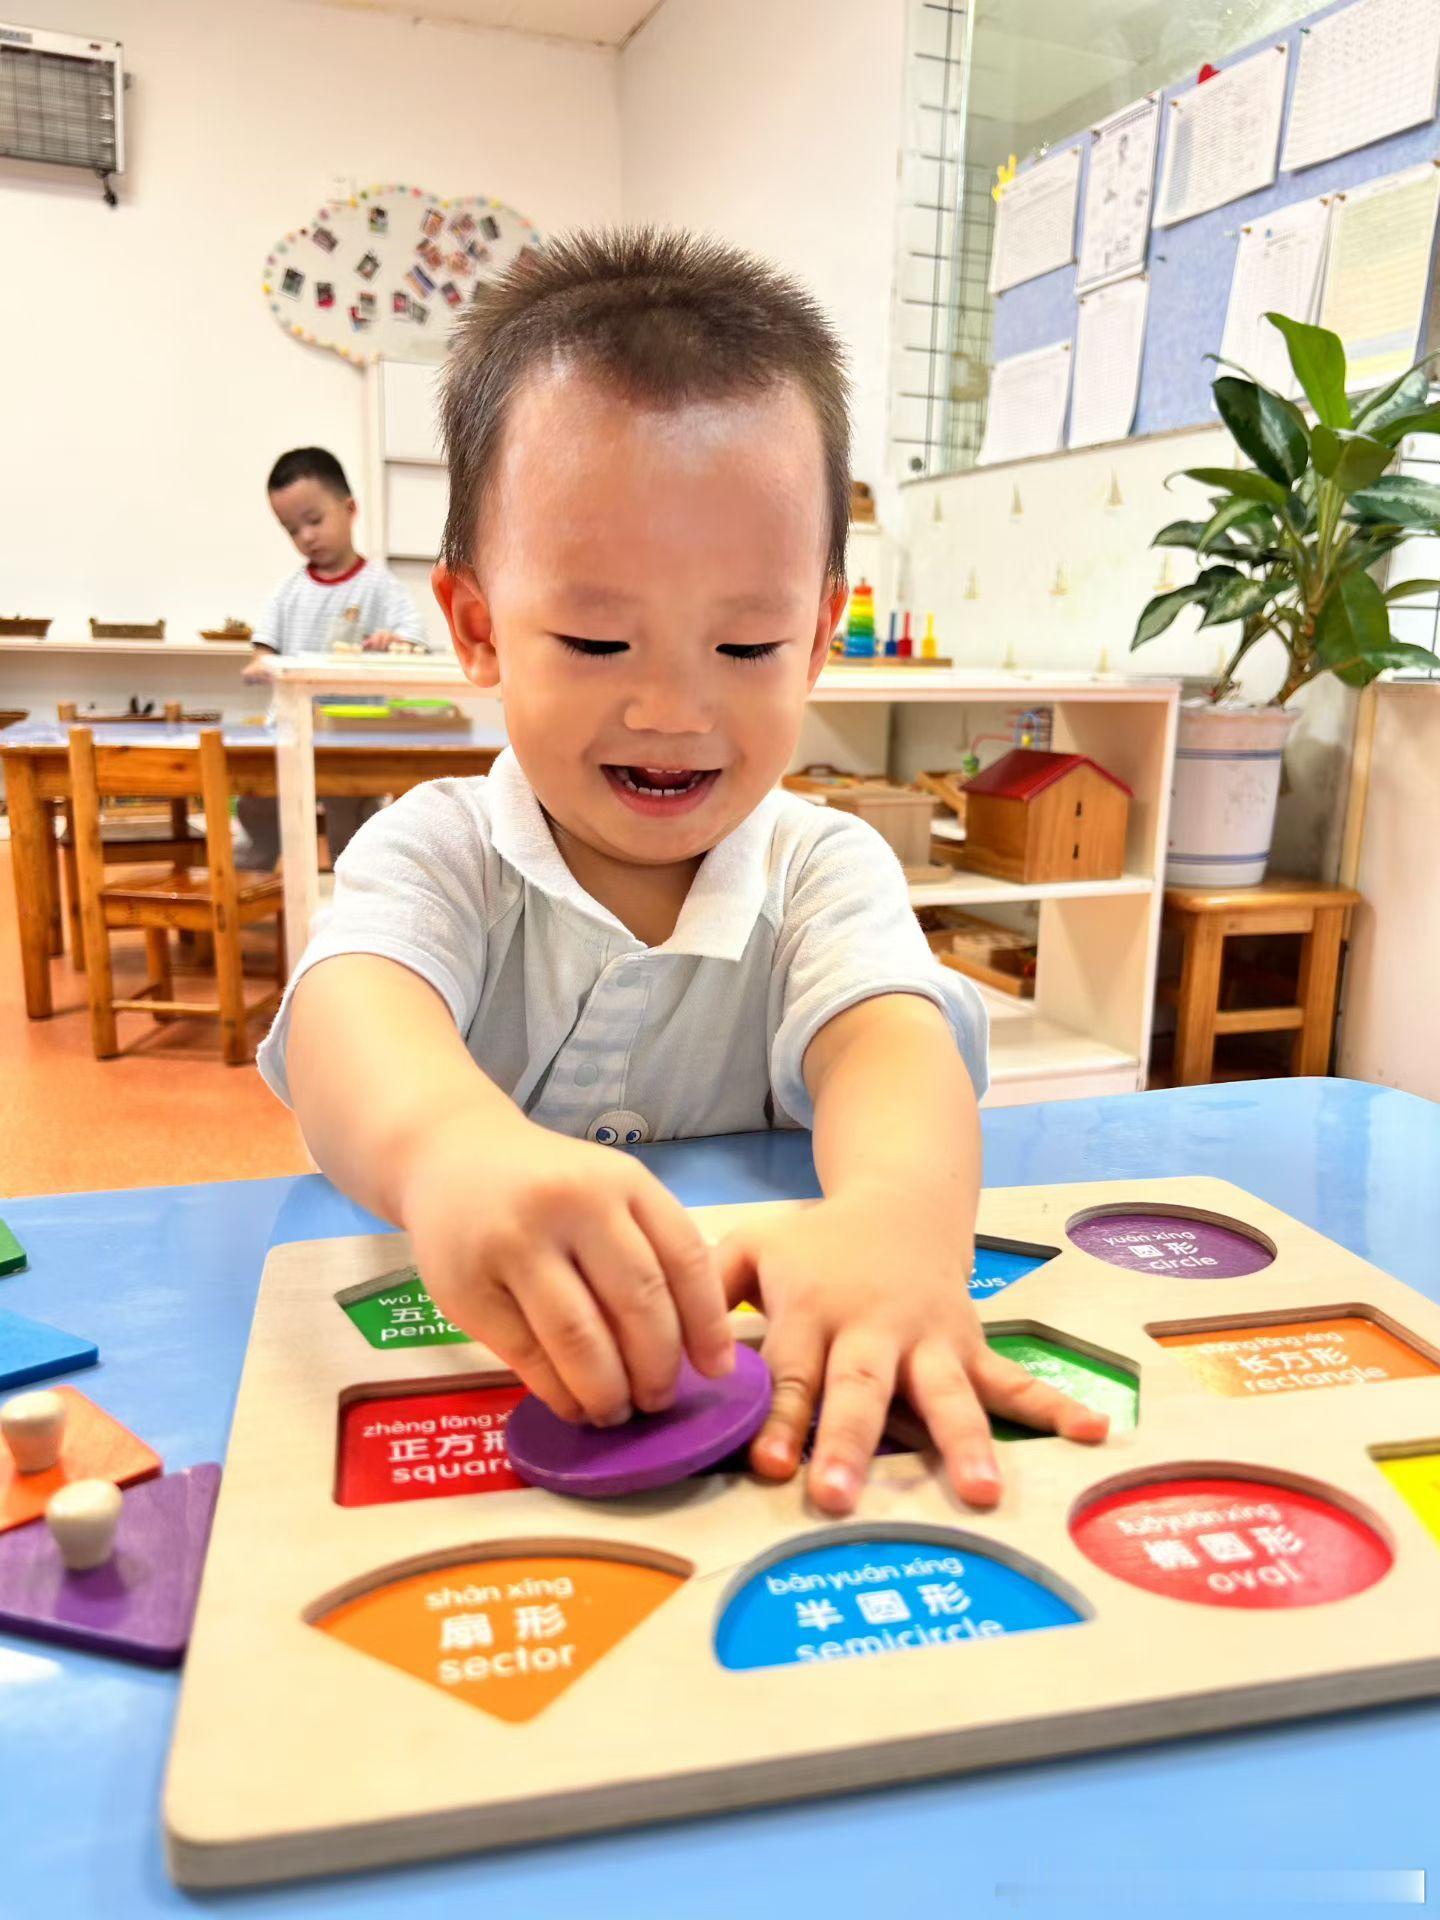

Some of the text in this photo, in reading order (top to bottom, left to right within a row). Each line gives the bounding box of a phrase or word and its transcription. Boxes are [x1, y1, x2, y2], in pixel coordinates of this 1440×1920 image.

[1149, 1255, 1218, 1270] circle
[1236, 1346, 1349, 1374] 长方形
[1244, 1365, 1388, 1391] rectangle
[1206, 1558, 1303, 1594] oval
[440, 1602, 567, 1650] 扇形
[795, 1581, 972, 1632] 半圆形
[796, 1616, 1005, 1662] semicircle
[438, 1643, 576, 1686] sector
